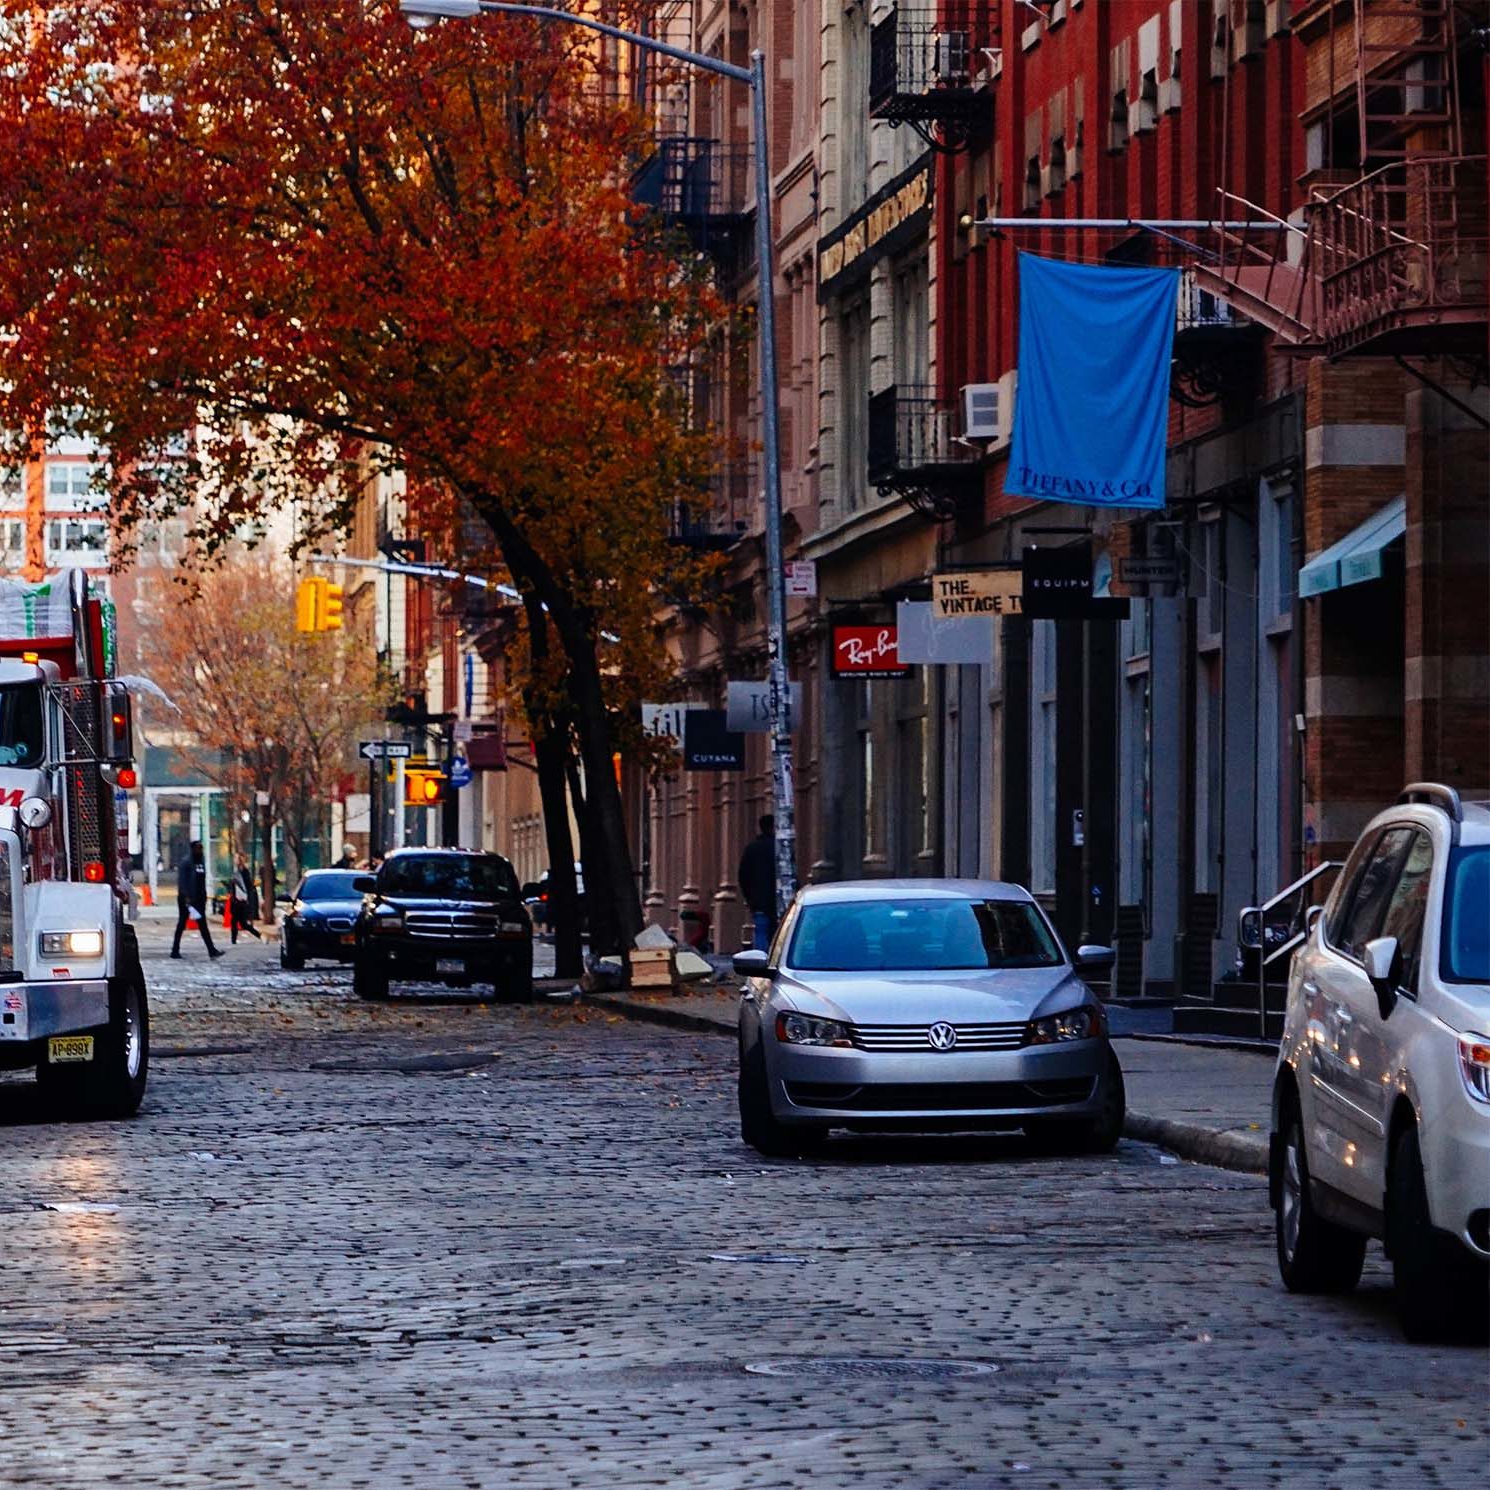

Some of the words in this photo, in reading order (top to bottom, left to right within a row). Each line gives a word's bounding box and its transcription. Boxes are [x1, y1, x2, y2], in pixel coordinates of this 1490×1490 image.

[1018, 466, 1098, 496] TIFFANY
[1101, 480, 1116, 497] &
[941, 595, 1002, 614] VINTAGE
[693, 753, 737, 763] CUYANA
